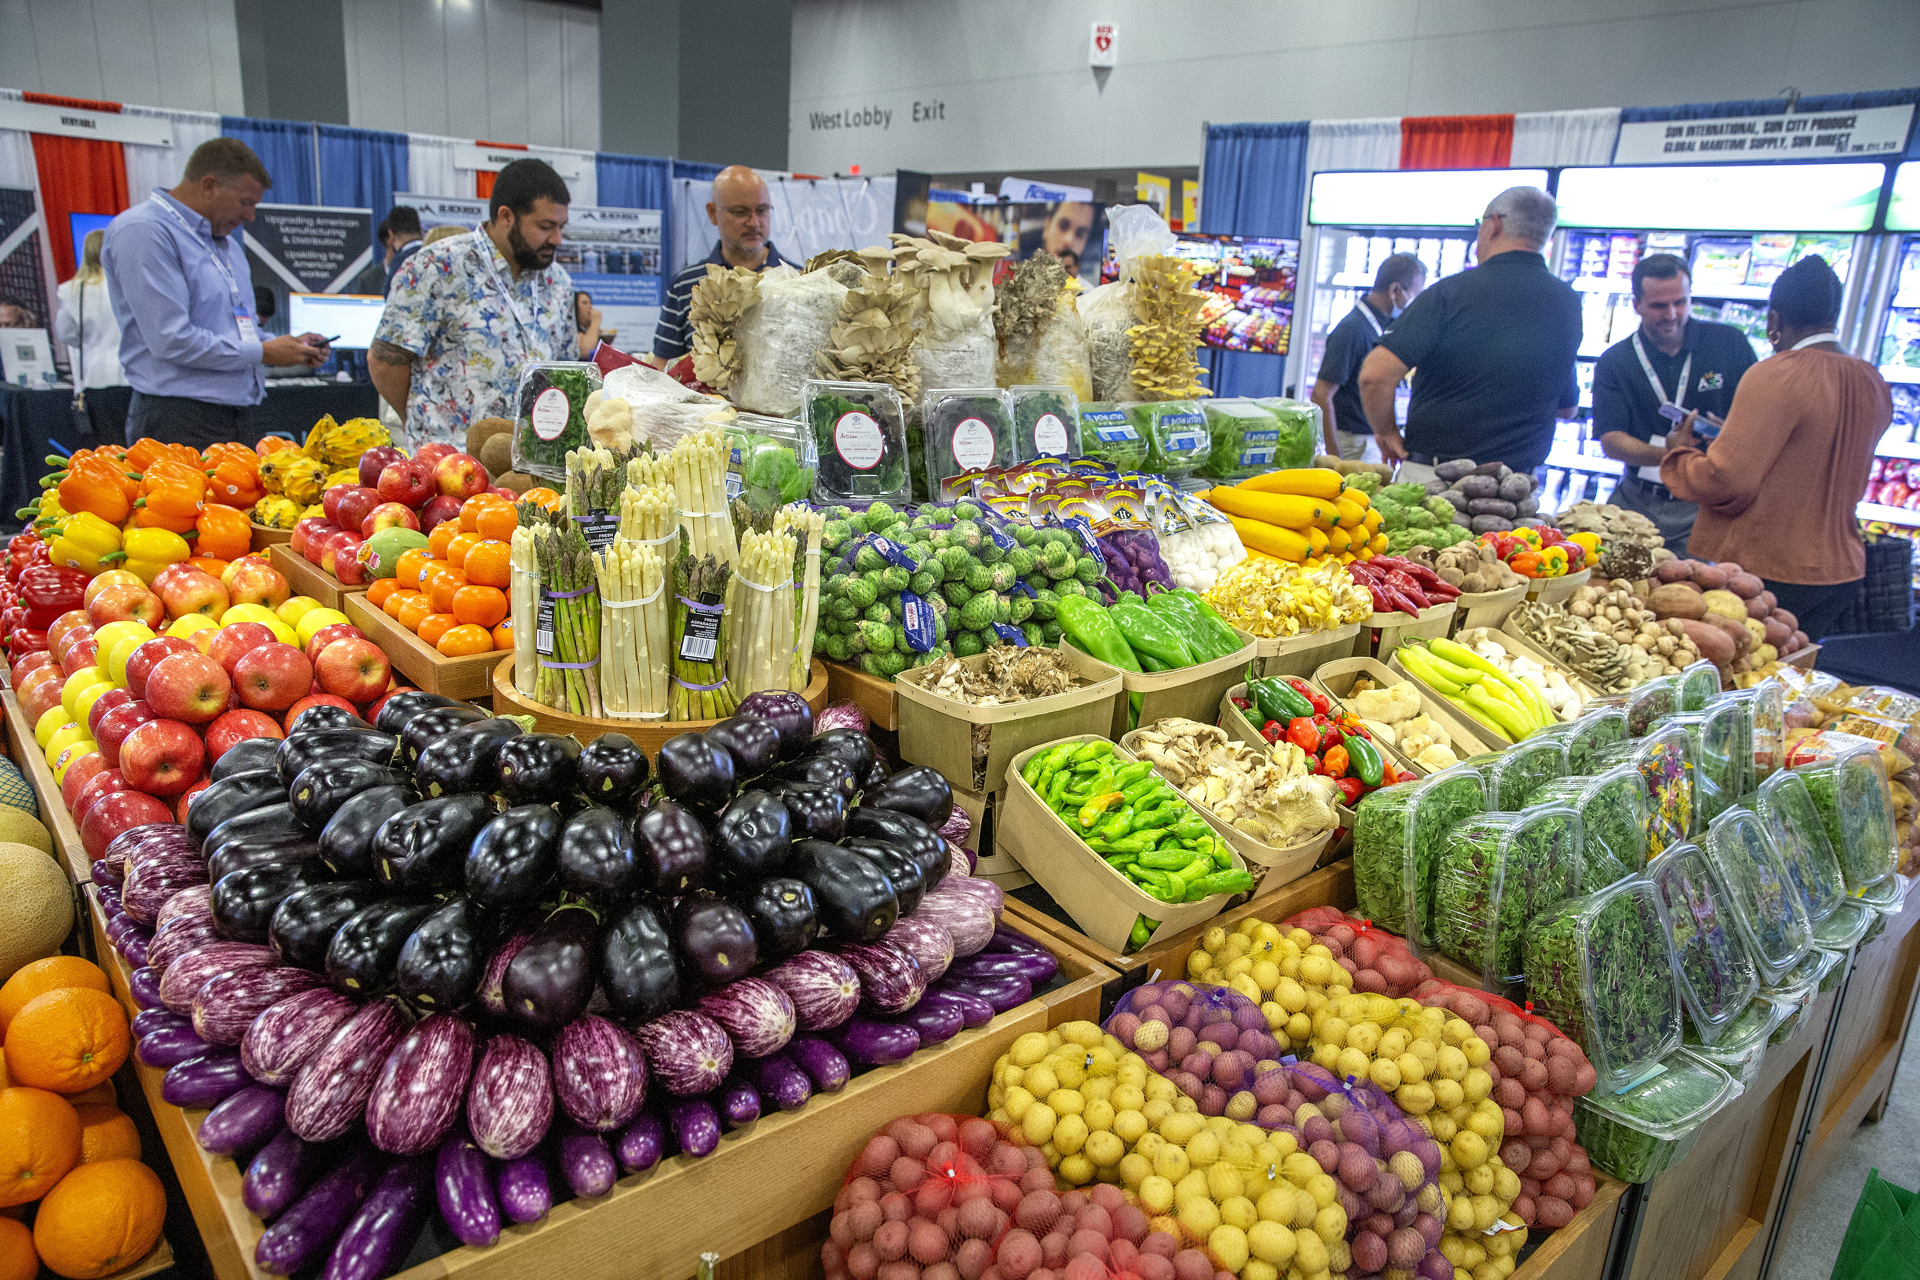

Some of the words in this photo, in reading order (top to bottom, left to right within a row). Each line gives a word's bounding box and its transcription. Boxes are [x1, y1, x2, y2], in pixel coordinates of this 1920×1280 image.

[808, 110, 841, 131] West
[844, 104, 893, 131] Lobby
[912, 99, 945, 123] Exit
[1665, 125, 1683, 138] SUN
[1685, 120, 1760, 137] INTERNATIONAL,
[1762, 119, 1783, 134] SUN
[1785, 118, 1809, 133] CITY
[1810, 114, 1858, 130] PRODUCE
[1663, 140, 1696, 153] GLOBAL
[1699, 138, 1747, 151] MARITIME
[1749, 135, 1787, 150] SUPPLY,
[1791, 134, 1812, 147] SUN
[1814, 132, 1852, 147] DIRECT
[264, 214, 315, 227] Upgrading
[315, 217, 360, 228] American
[279, 225, 347, 239] Manufacturing
[282, 234, 291, 244] &
[291, 235, 345, 247] Distribution.
[284, 249, 328, 261] Upskilling
[328, 250, 345, 261] the
[293, 260, 338, 270] American
[300, 270, 332, 279] worker.
[840, 432, 858, 440] Artisan
[690, 619, 718, 627] ASPARAGUS
